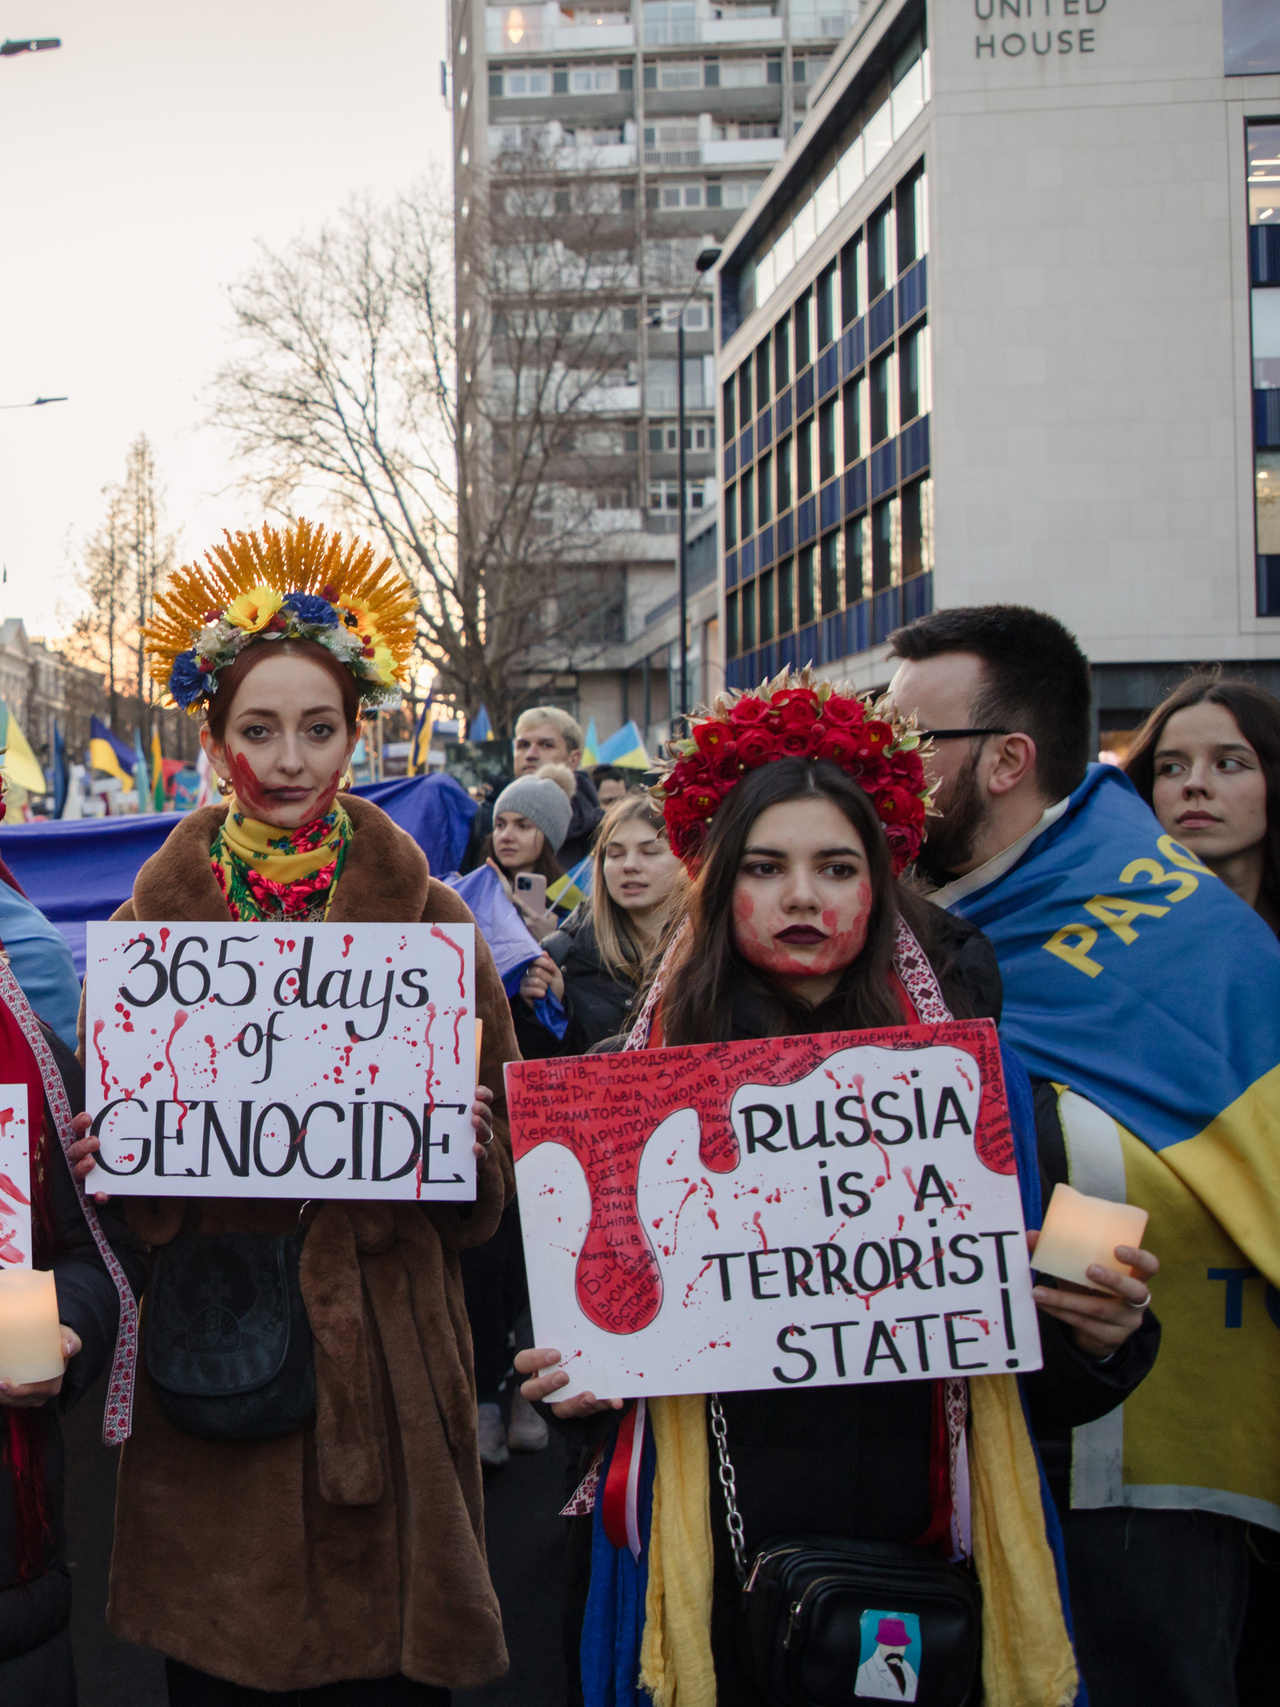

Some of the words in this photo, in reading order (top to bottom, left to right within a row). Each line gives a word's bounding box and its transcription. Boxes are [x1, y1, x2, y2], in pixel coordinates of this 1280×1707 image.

[976, 28, 1095, 59] HOUSE
[118, 934, 259, 1007] 365
[273, 936, 430, 1042] days
[237, 1011, 288, 1084] of
[91, 1087, 467, 1184] GENOCIDE
[738, 1069, 972, 1154] RUSSIA
[914, 1164, 955, 1212] A
[702, 1219, 1019, 1301] TERRORIST
[773, 1287, 1019, 1384] STATE!
